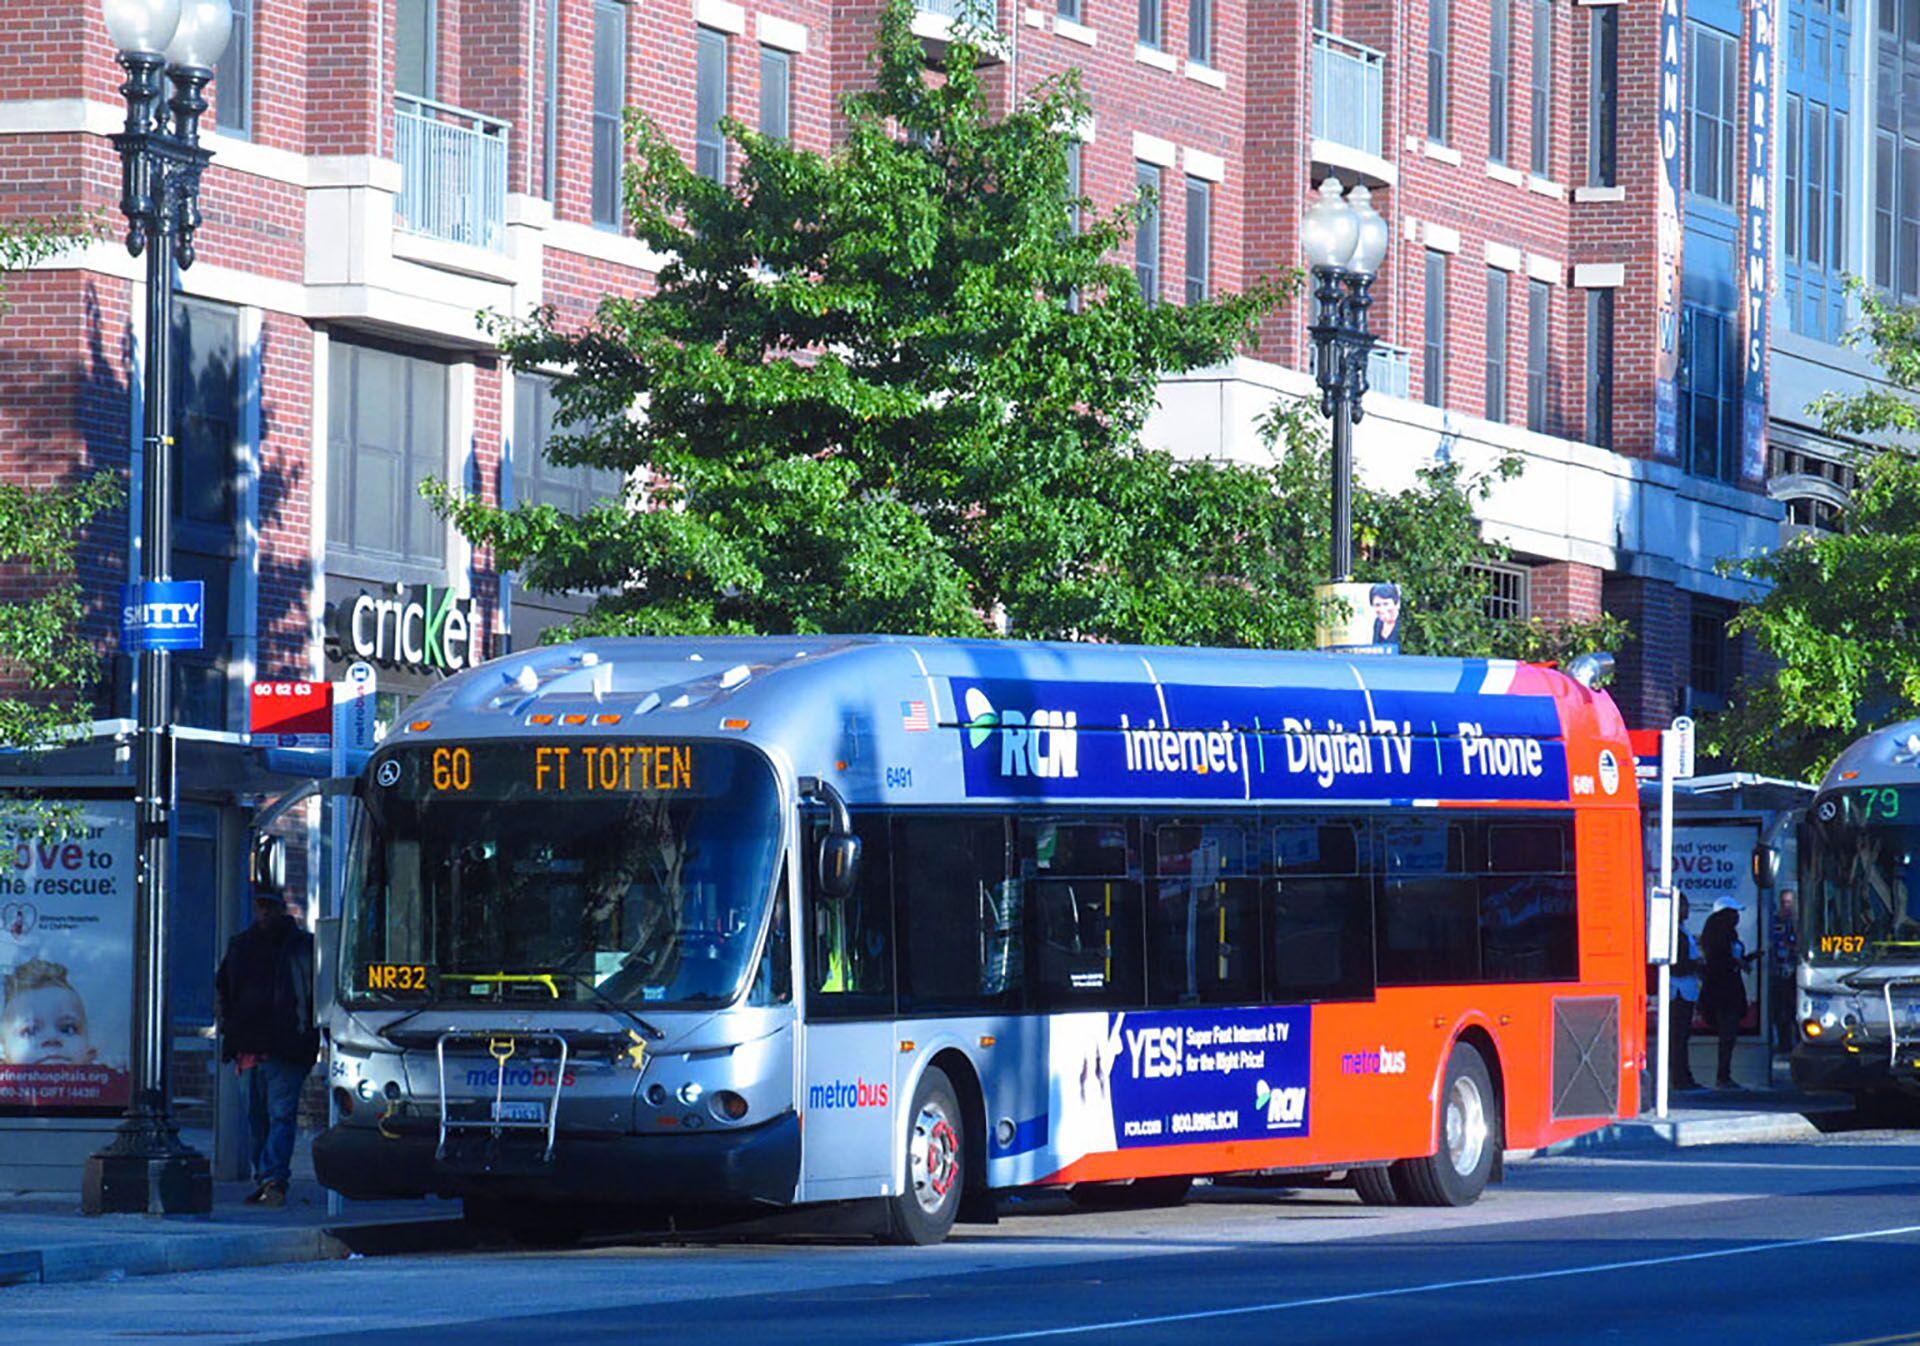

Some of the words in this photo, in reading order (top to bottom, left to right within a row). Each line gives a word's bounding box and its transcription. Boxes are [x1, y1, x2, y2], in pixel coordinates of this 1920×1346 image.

[1750, 0, 1767, 372] PARTMENTS
[254, 684, 272, 695] 60
[275, 684, 292, 695] 62
[294, 684, 311, 695] 63
[1001, 710, 1078, 778] RCN
[1121, 714, 1238, 772] Internet
[1283, 718, 1371, 788] Digital
[1372, 720, 1412, 775] TV
[1458, 722, 1543, 777] Phone
[432, 747, 471, 790] 60
[535, 747, 570, 790] FT
[581, 746, 693, 789] TOTTEN
[886, 766, 913, 788] 6491
[1860, 788, 1899, 818] 79
[13, 844, 83, 870] ove
[87, 849, 113, 869] to
[1696, 843, 1728, 855] your
[1716, 859, 1734, 872] to
[0, 876, 25, 895] he
[1821, 936, 1865, 953] N767
[368, 966, 427, 990] NR32
[1186, 1026, 1212, 1049] Super
[1276, 1023, 1289, 1041] TV
[1126, 1026, 1183, 1078] YES!
[1186, 1053, 1200, 1071] for
[1200, 1053, 1215, 1071] the
[1342, 1045, 1406, 1073] metrobus
[466, 1066, 576, 1087] metrobus
[809, 1076, 888, 1108] metrobus
[1267, 1087, 1306, 1122] RCN
